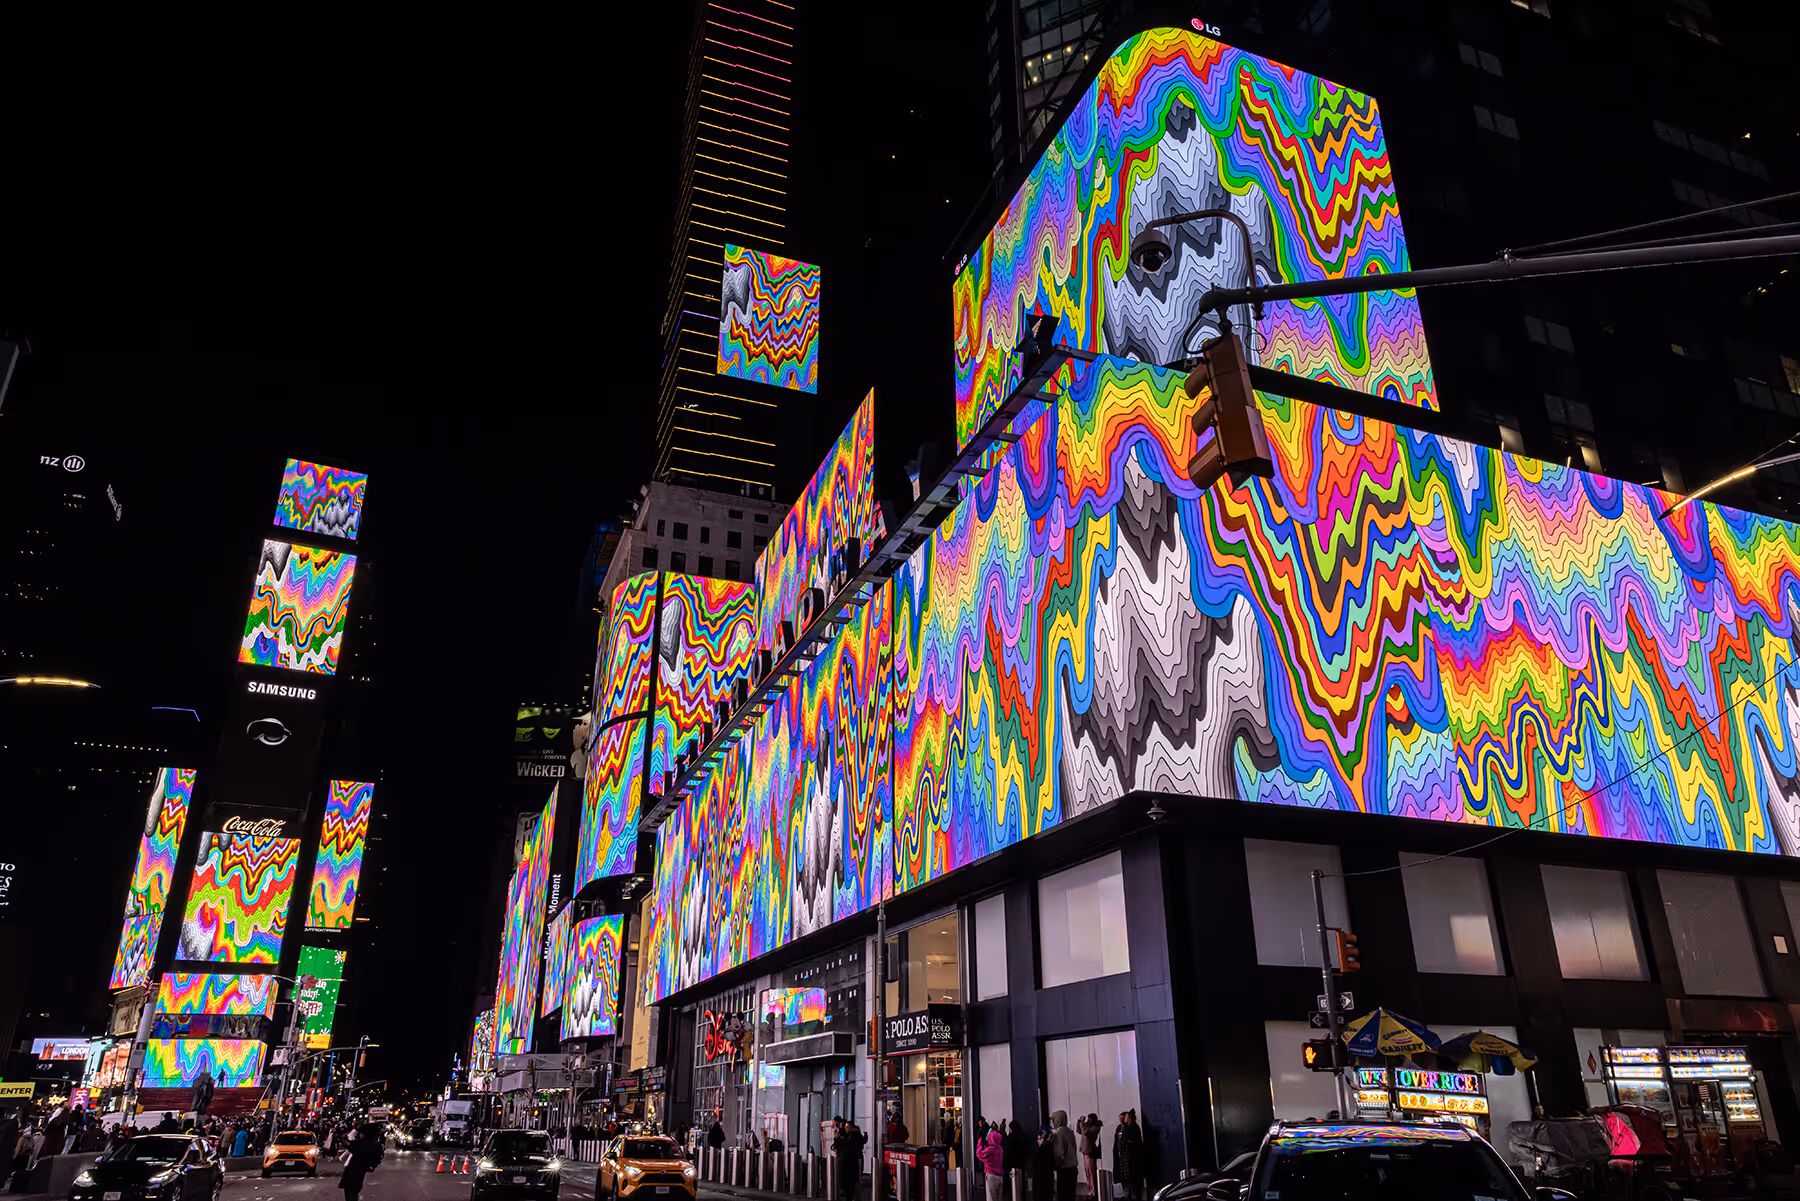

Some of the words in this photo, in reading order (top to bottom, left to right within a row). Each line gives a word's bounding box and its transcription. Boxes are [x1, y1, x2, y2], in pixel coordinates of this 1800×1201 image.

[1205, 23, 1221, 36] LG
[40, 455, 60, 467] nz
[247, 681, 317, 700] SAMSUNG
[222, 815, 287, 837] Coca-Cola
[548, 873, 562, 915] Moment
[891, 1017, 914, 1039] POLO
[931, 1032, 953, 1040] ASSN.
[1400, 1070, 1440, 1088] OVER
[1440, 1073, 1474, 1091] RICE
